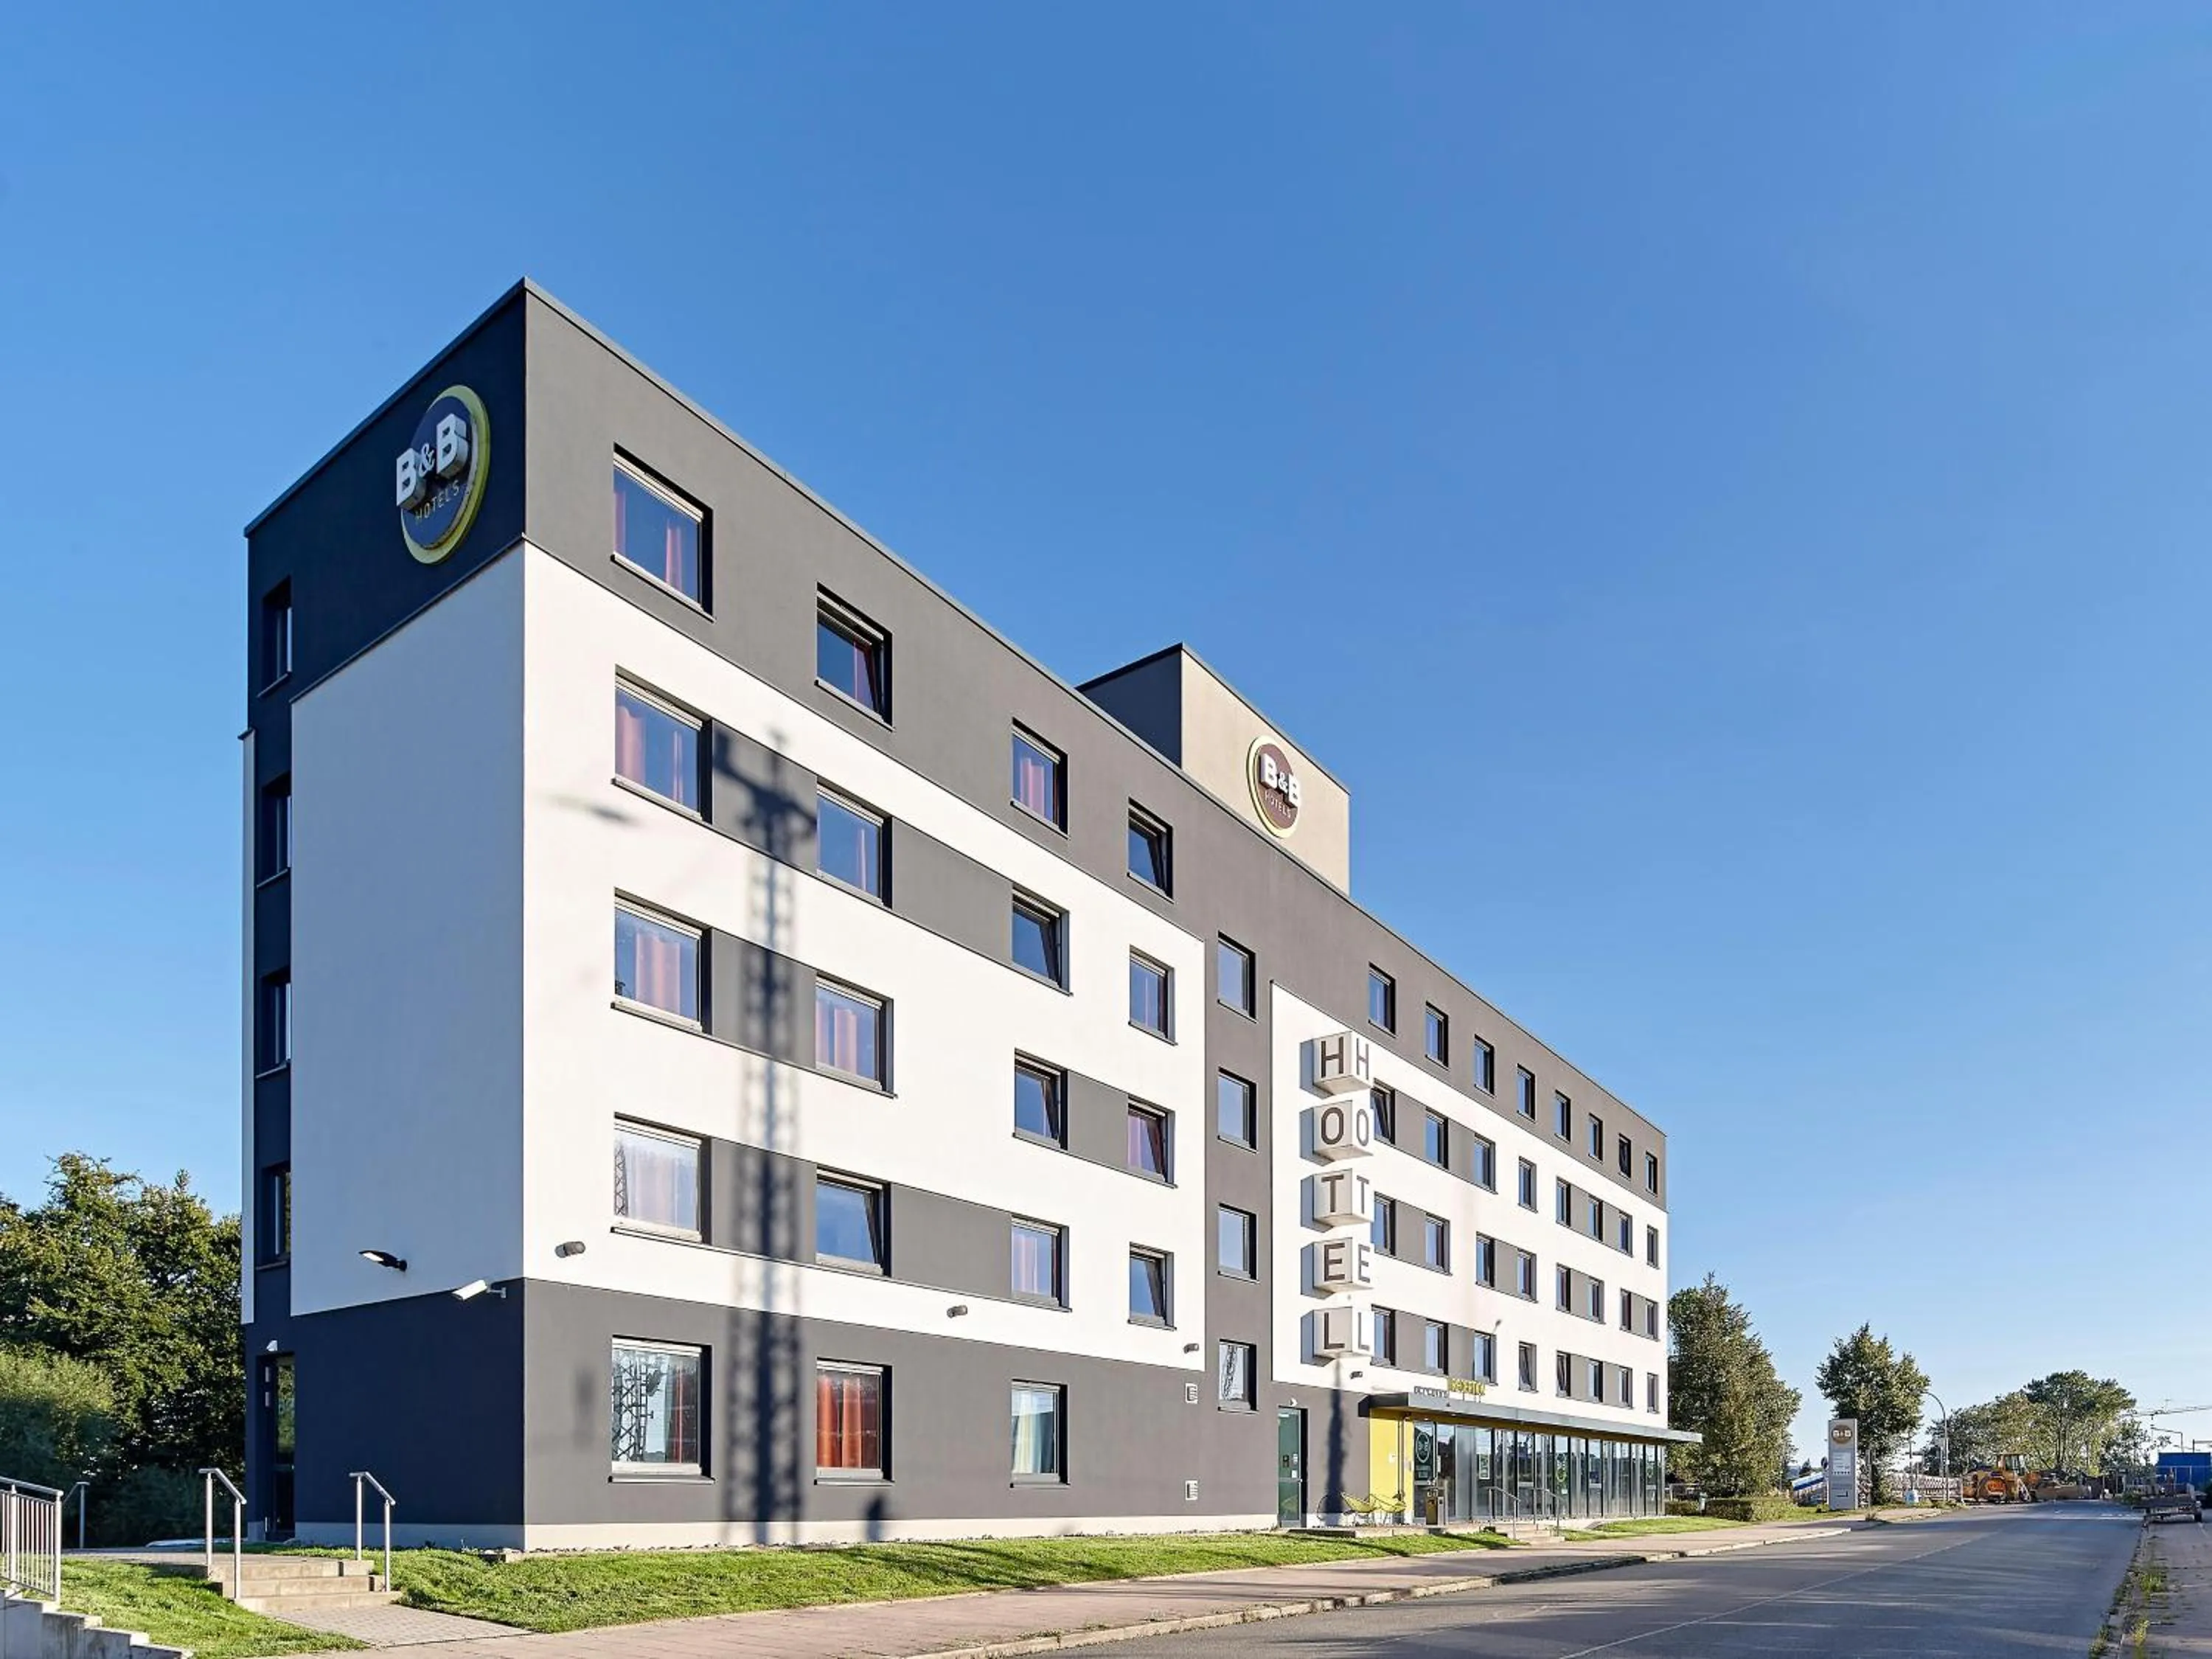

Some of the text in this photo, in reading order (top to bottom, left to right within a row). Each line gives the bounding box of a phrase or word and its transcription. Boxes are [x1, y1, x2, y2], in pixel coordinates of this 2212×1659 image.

[396, 414, 467, 507] B&B
[1262, 754, 1300, 807] B&B
[1321, 1036, 1346, 1350] HOTEL
[1356, 1037, 1371, 1350] HOTEL
